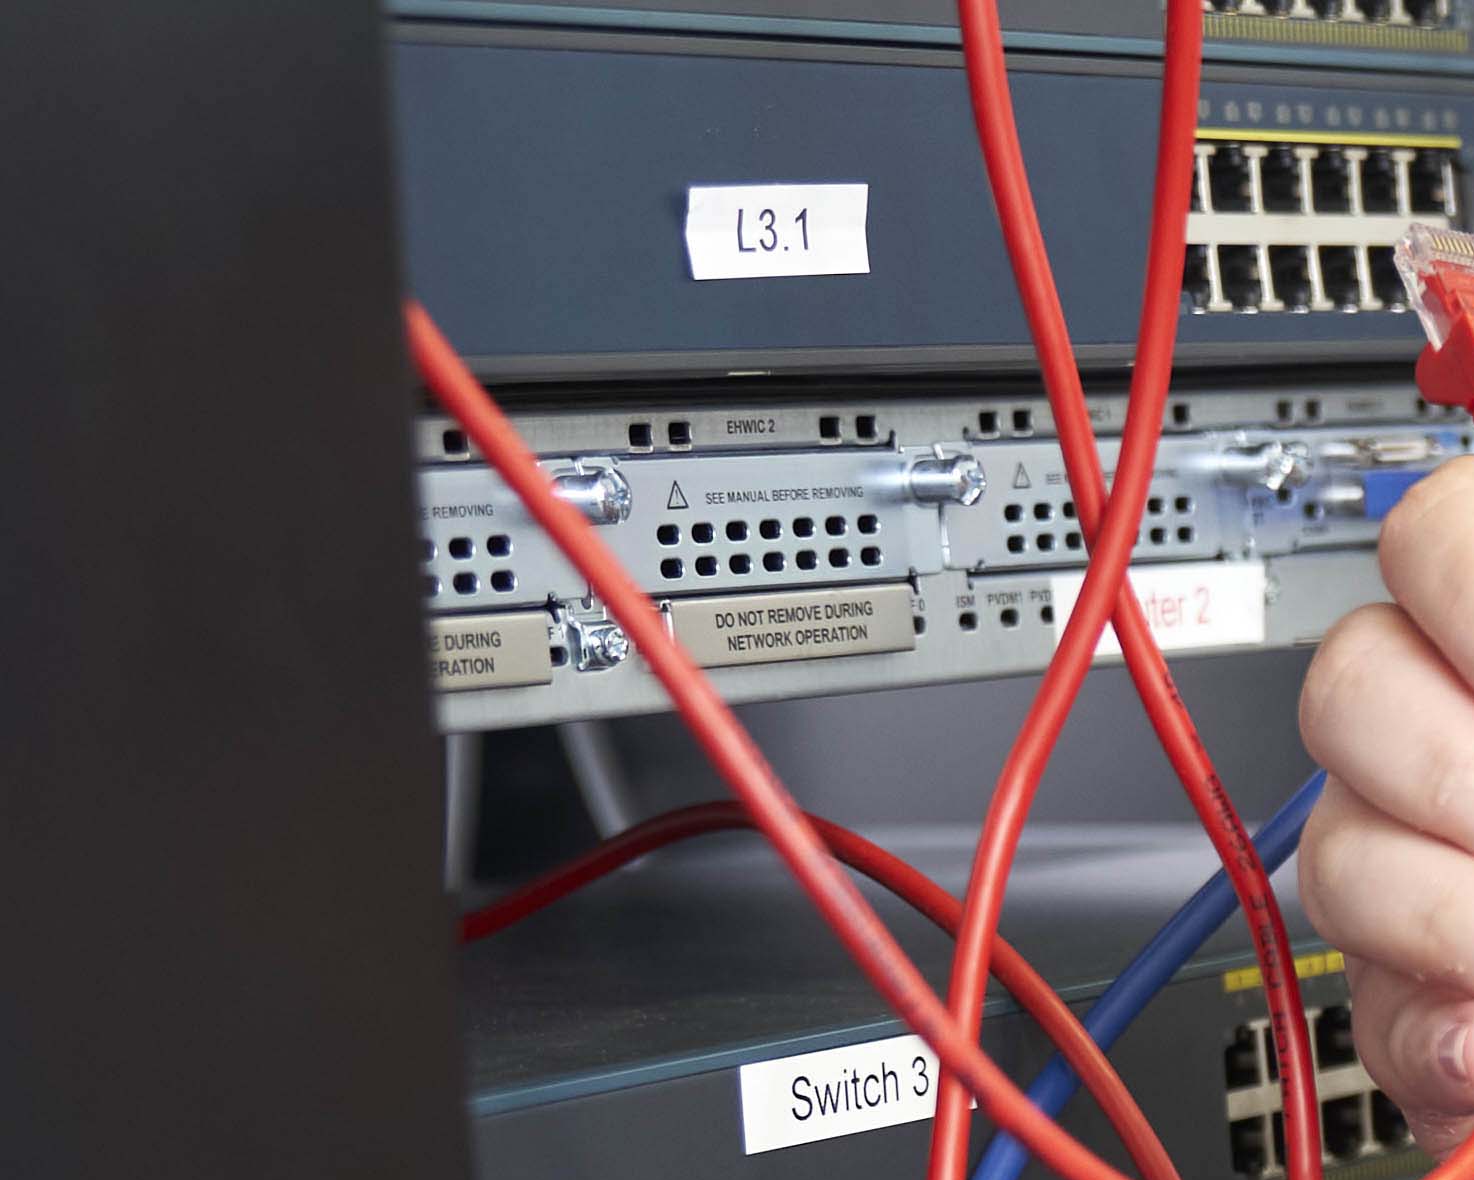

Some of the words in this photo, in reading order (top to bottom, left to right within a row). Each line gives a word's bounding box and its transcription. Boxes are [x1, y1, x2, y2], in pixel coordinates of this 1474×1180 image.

[737, 208, 811, 253] L3.1
[727, 419, 766, 434] EHWIC
[768, 419, 775, 433] 2
[705, 492, 725, 505] SEE
[727, 489, 770, 503] MANUAL
[772, 487, 808, 501] BEFORE
[812, 486, 864, 499] REMOVING
[432, 504, 494, 519] REMOVING
[715, 612, 735, 629] DO
[738, 610, 764, 627] NOT
[768, 605, 822, 625] REMOVE
[824, 601, 874, 620] DURING
[1193, 584, 1210, 625] 2
[444, 631, 502, 652] DURING
[727, 631, 793, 652] NETWORK
[795, 625, 868, 645] OPERATION
[791, 1061, 900, 1121] Switch
[912, 1055, 930, 1097] 3
